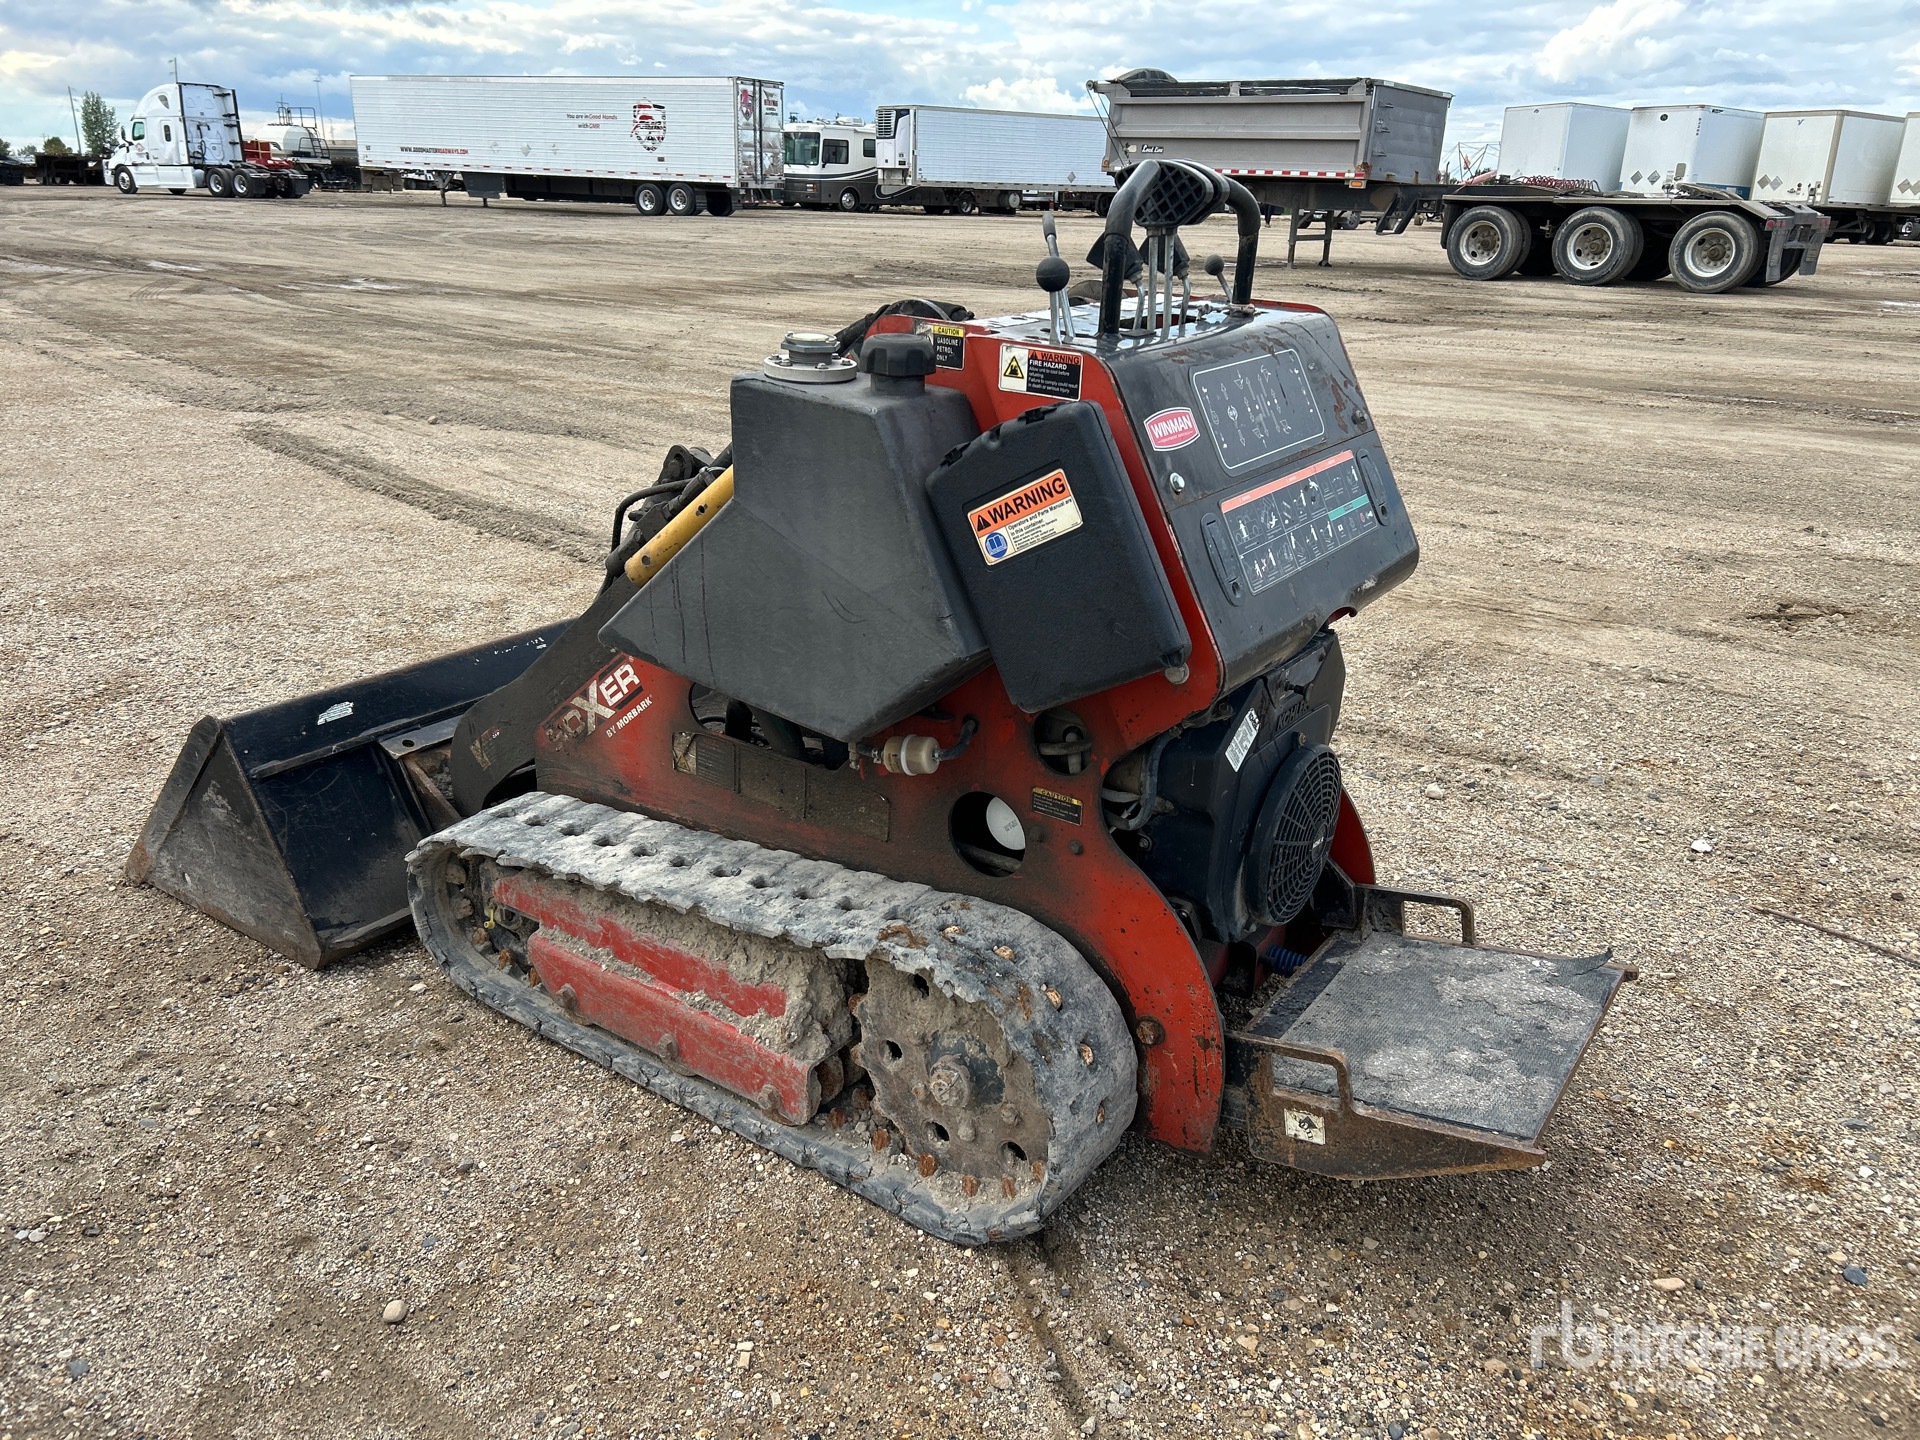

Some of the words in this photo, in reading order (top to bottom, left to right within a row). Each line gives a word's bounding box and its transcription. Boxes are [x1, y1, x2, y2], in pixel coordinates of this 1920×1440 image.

[937, 326, 960, 336] CAUTION
[936, 345, 954, 355] PETROL
[936, 354, 948, 362] ONLY
[1041, 352, 1080, 364] WARNING
[1029, 359, 1042, 367] FIRE
[1043, 361, 1068, 370] HAZARD
[1150, 414, 1193, 439] WINMAN
[988, 477, 1066, 524] WARNING
[1049, 502, 1065, 512] Manual
[605, 726, 617, 738] BY
[616, 696, 653, 730] MORBARK
